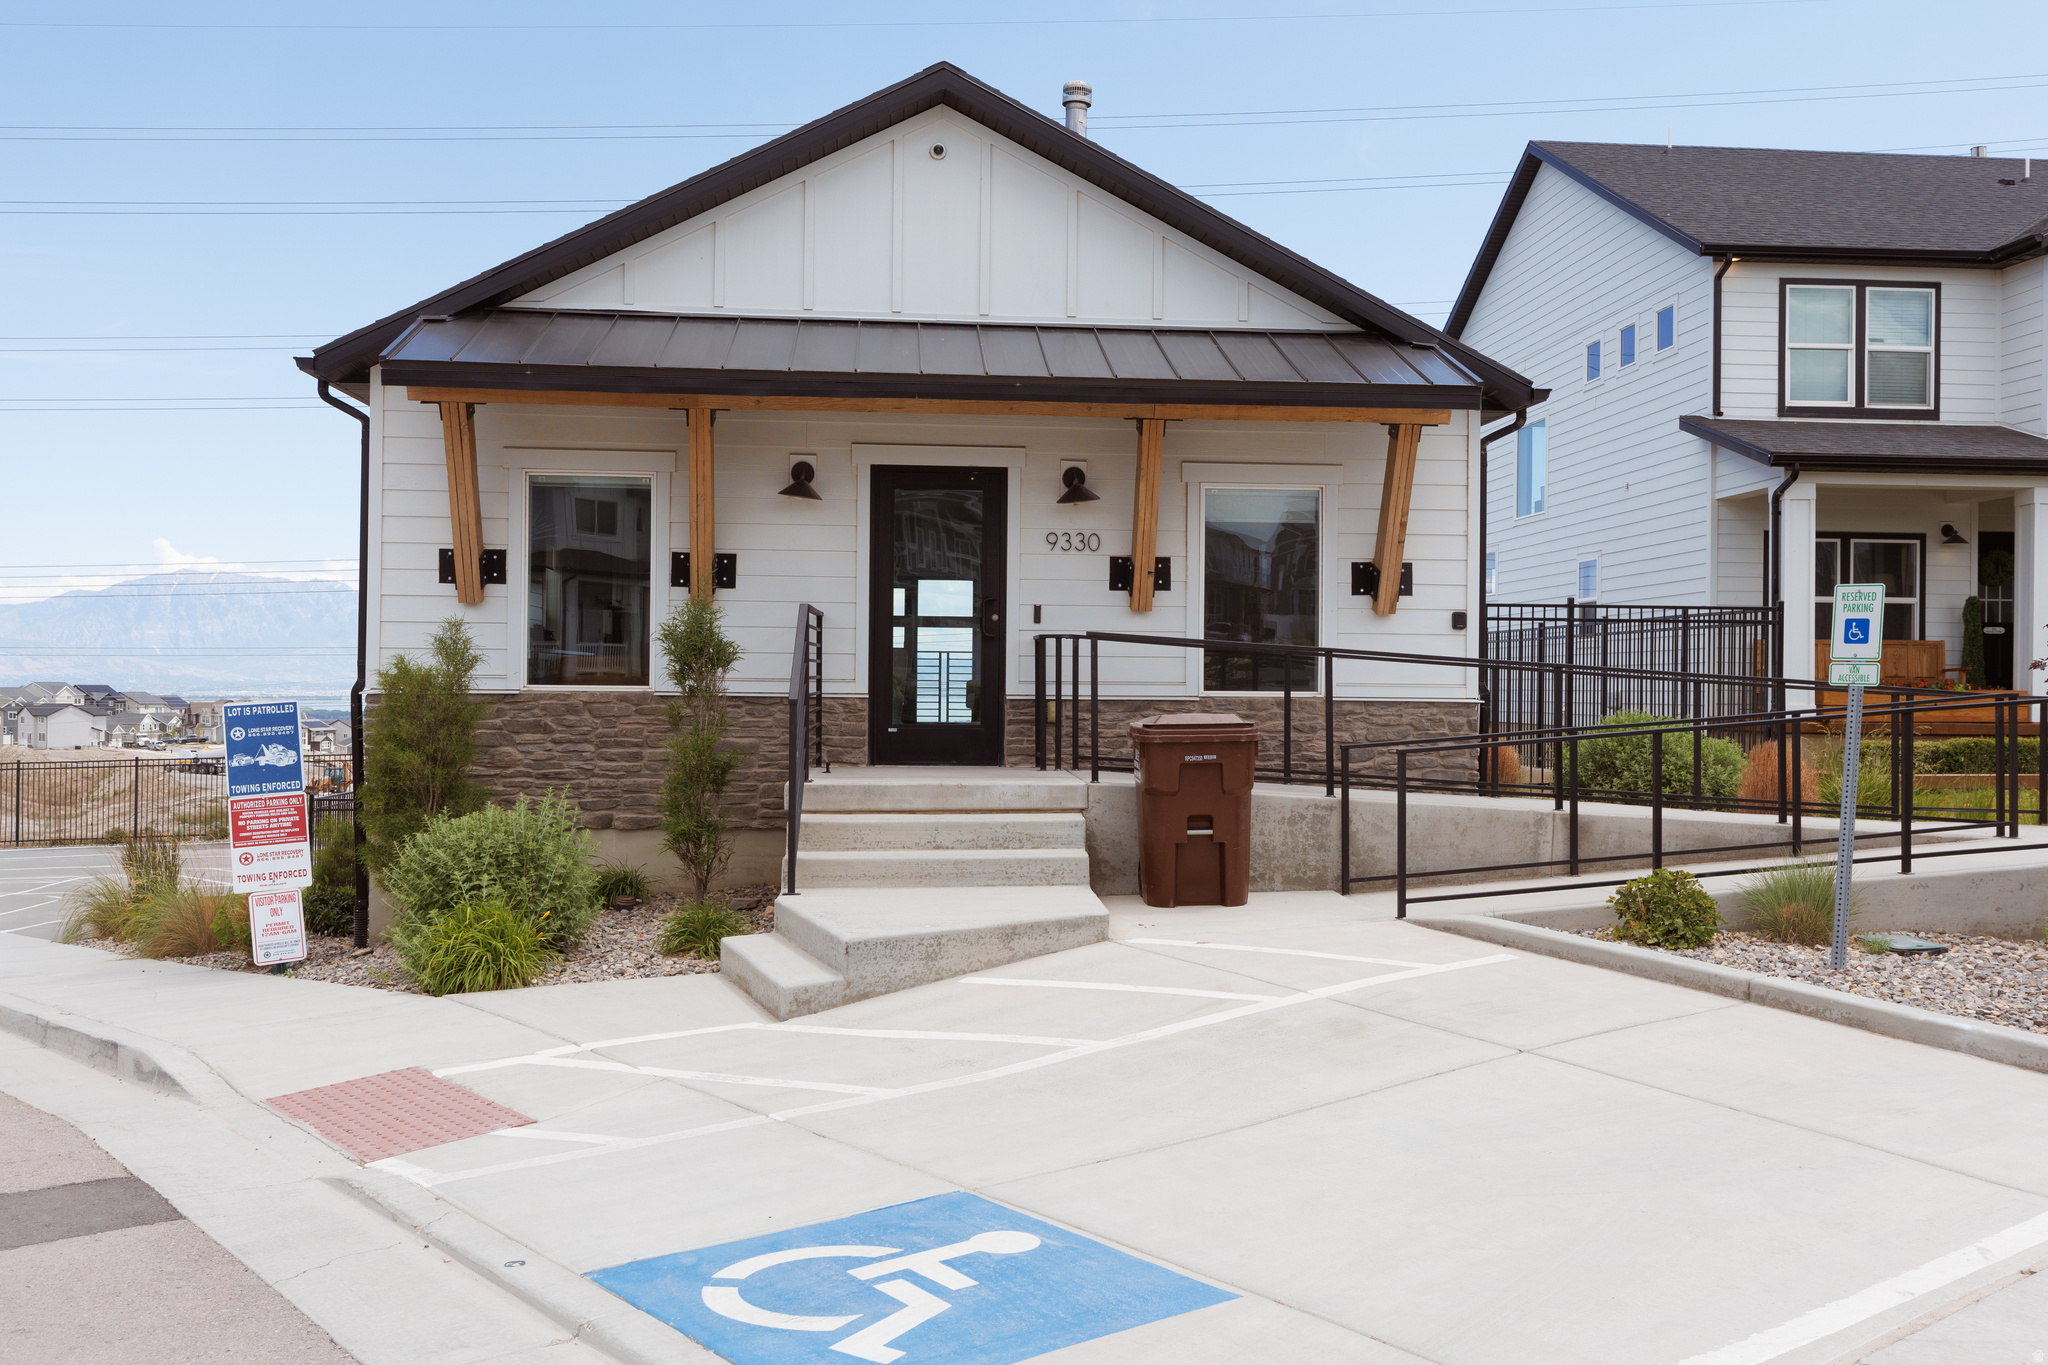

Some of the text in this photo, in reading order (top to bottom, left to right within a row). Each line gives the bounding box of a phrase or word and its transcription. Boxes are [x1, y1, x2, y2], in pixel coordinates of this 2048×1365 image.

[1046, 532, 1100, 552] 9330
[1842, 592, 1876, 601] RESERVED
[1843, 603, 1874, 612] PARKING
[1838, 674, 1870, 682] ACCESSIBLE
[228, 704, 294, 716] LOT IS PATROLLED
[231, 781, 300, 794] TOWING ENFORCED
[233, 800, 265, 809] AUTHORIZED
[266, 798, 288, 807] PARKING
[237, 869, 307, 883] TOWING ENFORCED
[255, 893, 296, 907] VISITOR PARKING
[270, 907, 283, 917] ONLY
